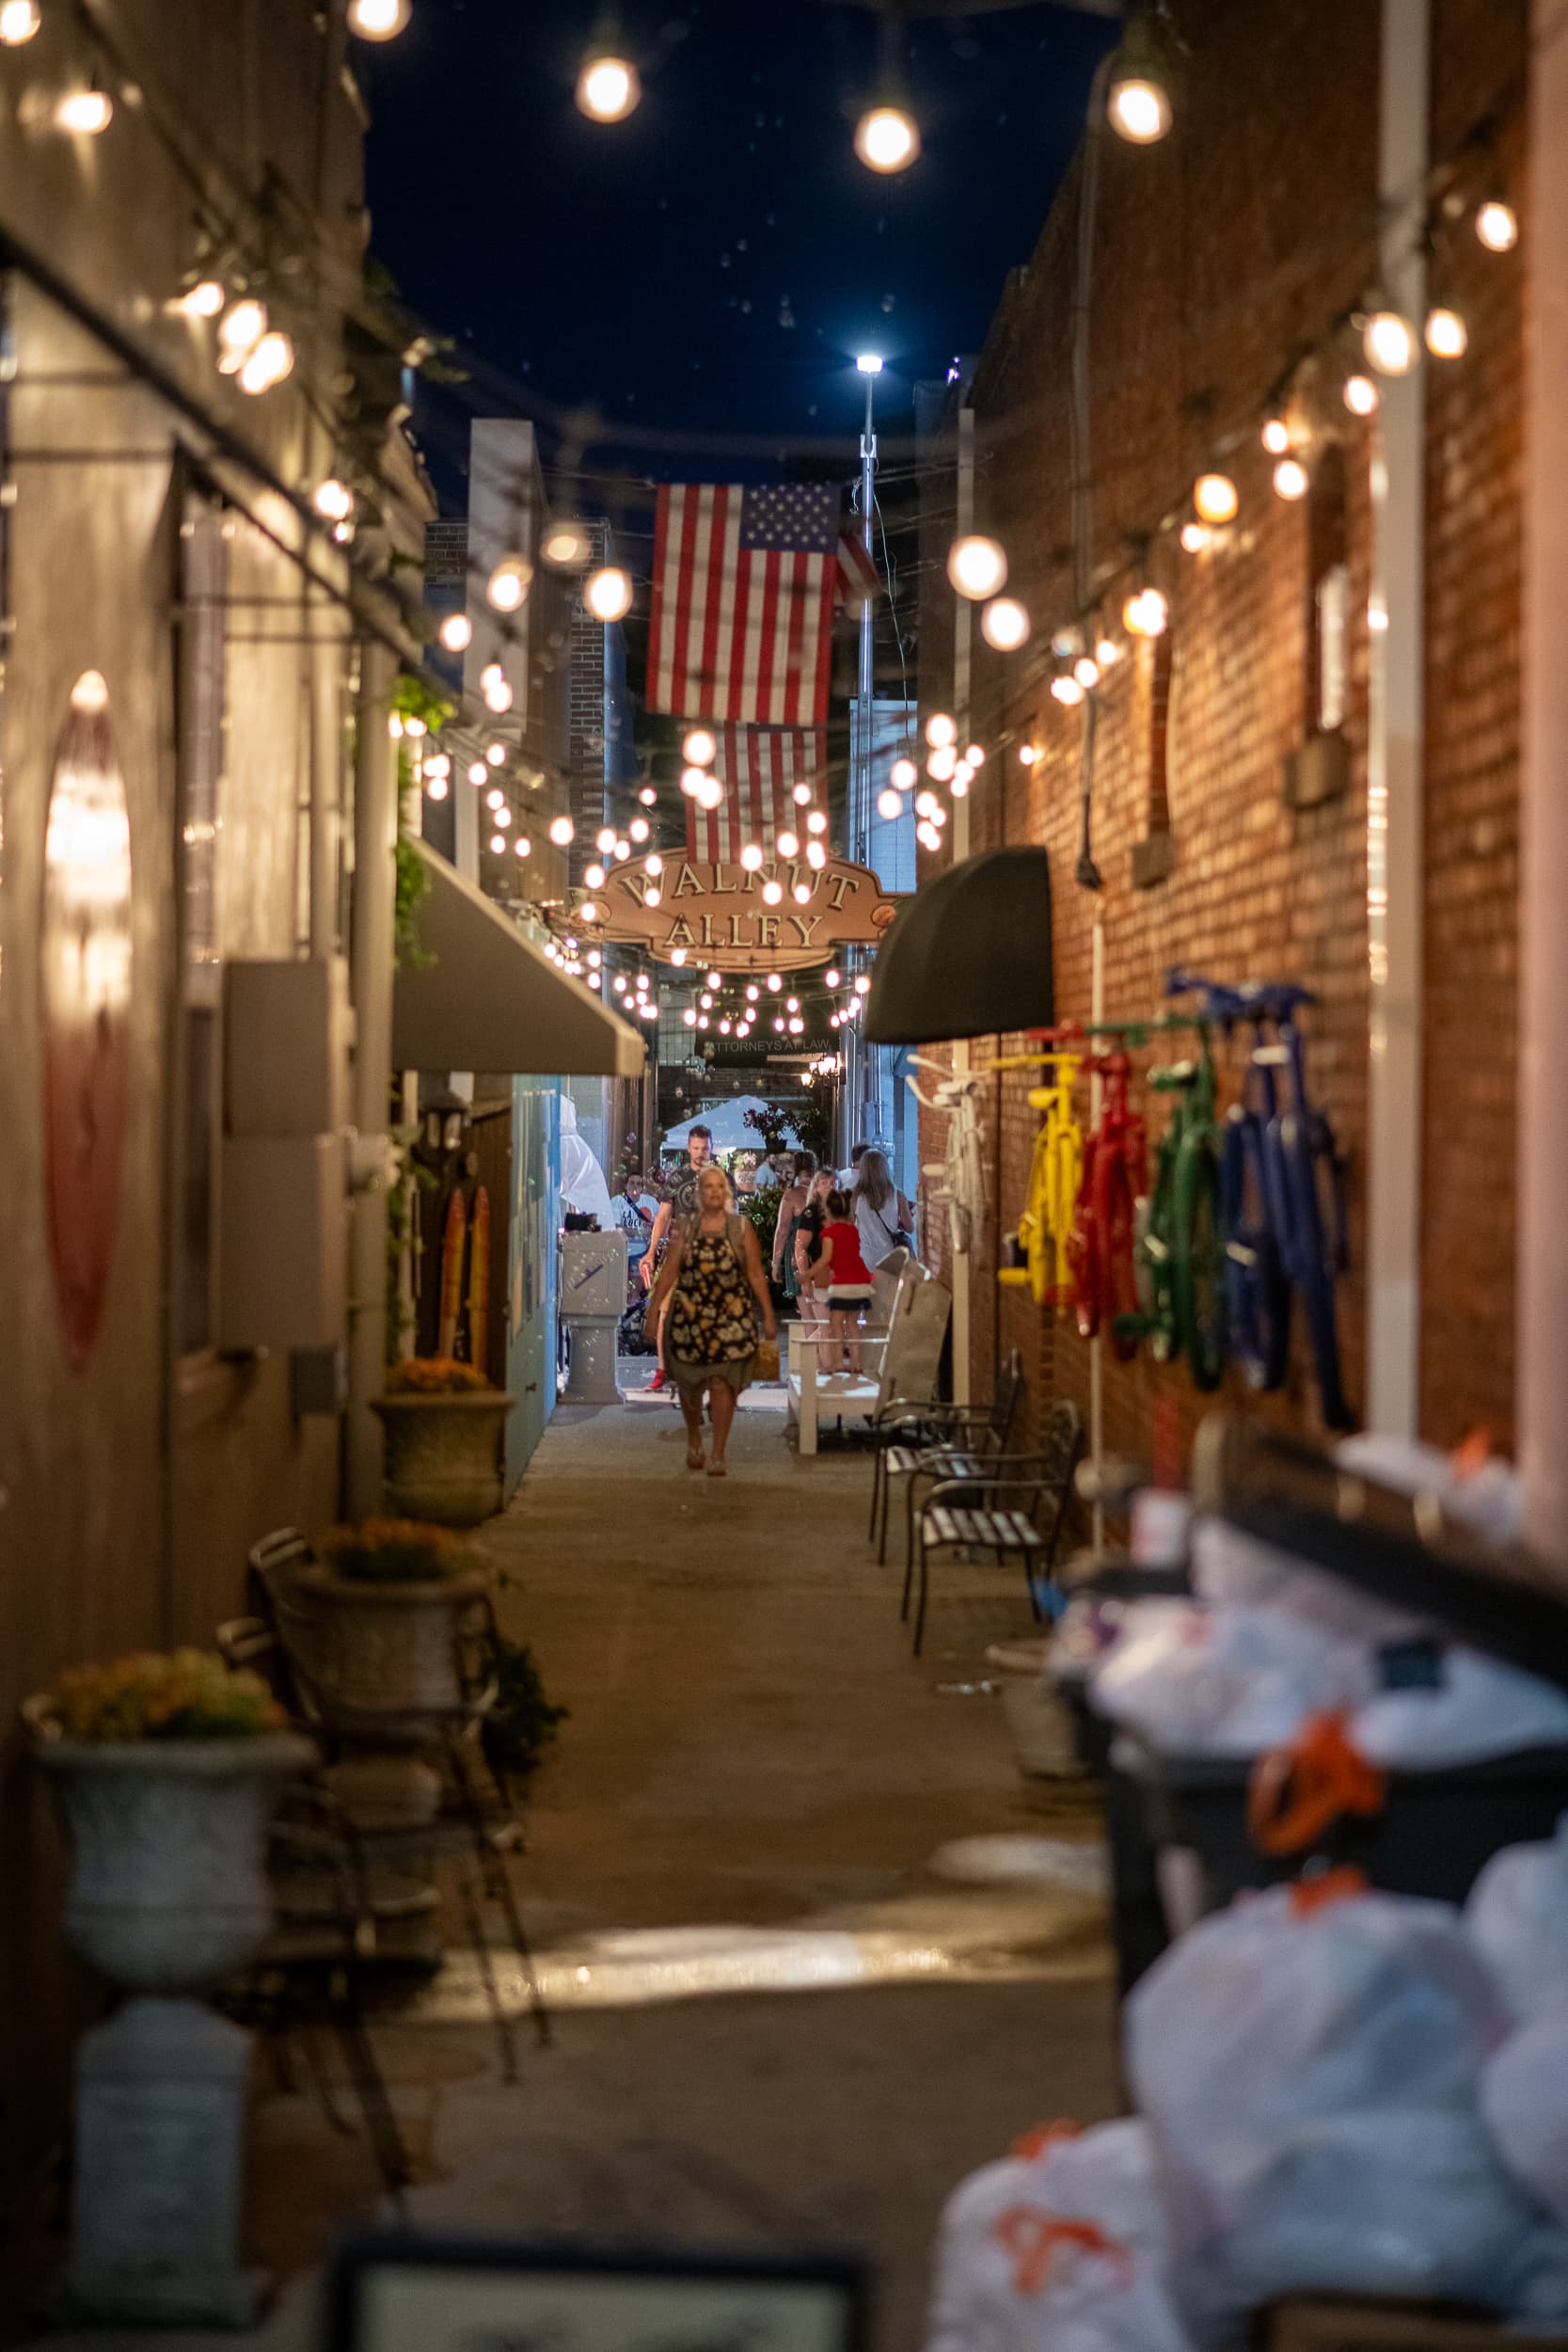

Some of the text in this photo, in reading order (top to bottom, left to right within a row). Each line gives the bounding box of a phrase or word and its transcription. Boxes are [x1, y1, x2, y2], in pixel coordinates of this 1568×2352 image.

[619, 862, 860, 911] WALNUT
[662, 914, 824, 948] ALLEY
[705, 1038, 830, 1054] ATTORNEYS AT LAW
